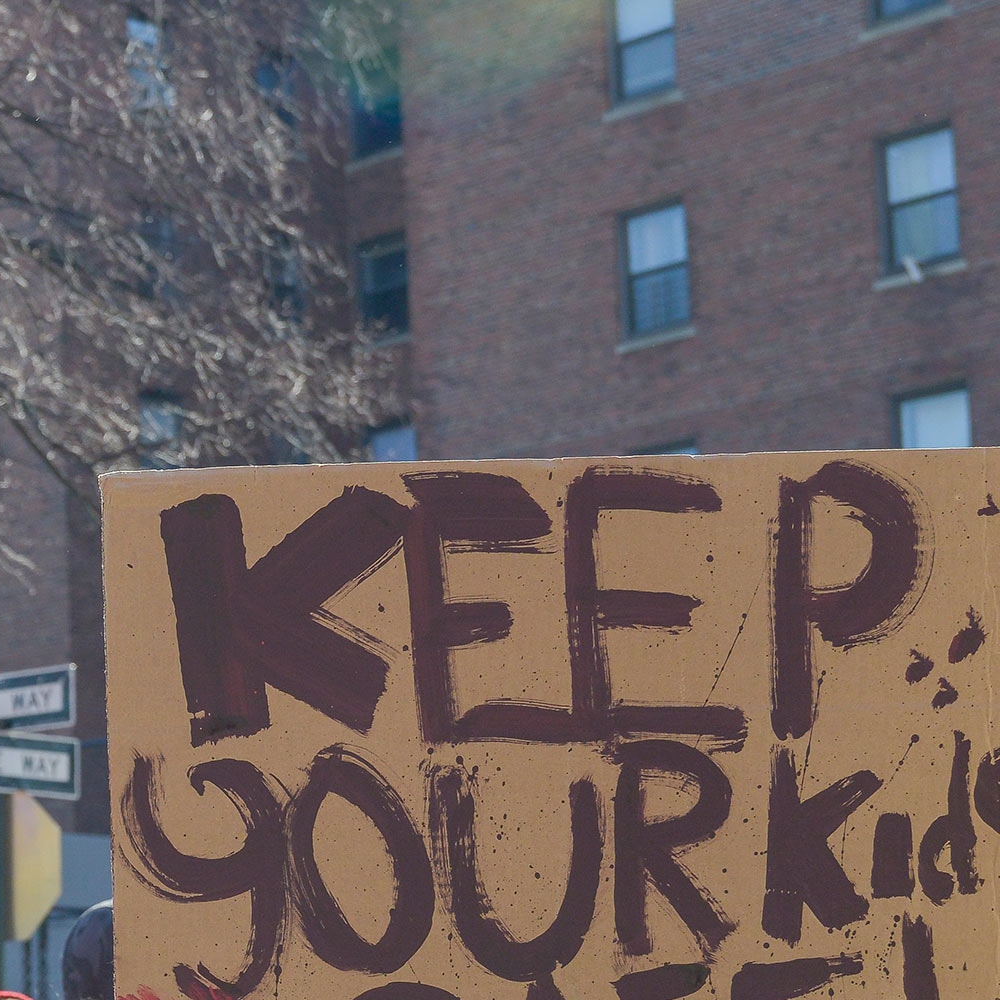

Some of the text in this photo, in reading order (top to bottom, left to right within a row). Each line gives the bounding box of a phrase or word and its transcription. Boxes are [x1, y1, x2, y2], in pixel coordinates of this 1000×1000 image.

[160, 460, 935, 747] KEEP
[11, 689, 51, 708] WAY
[22, 754, 60, 773] WAY
